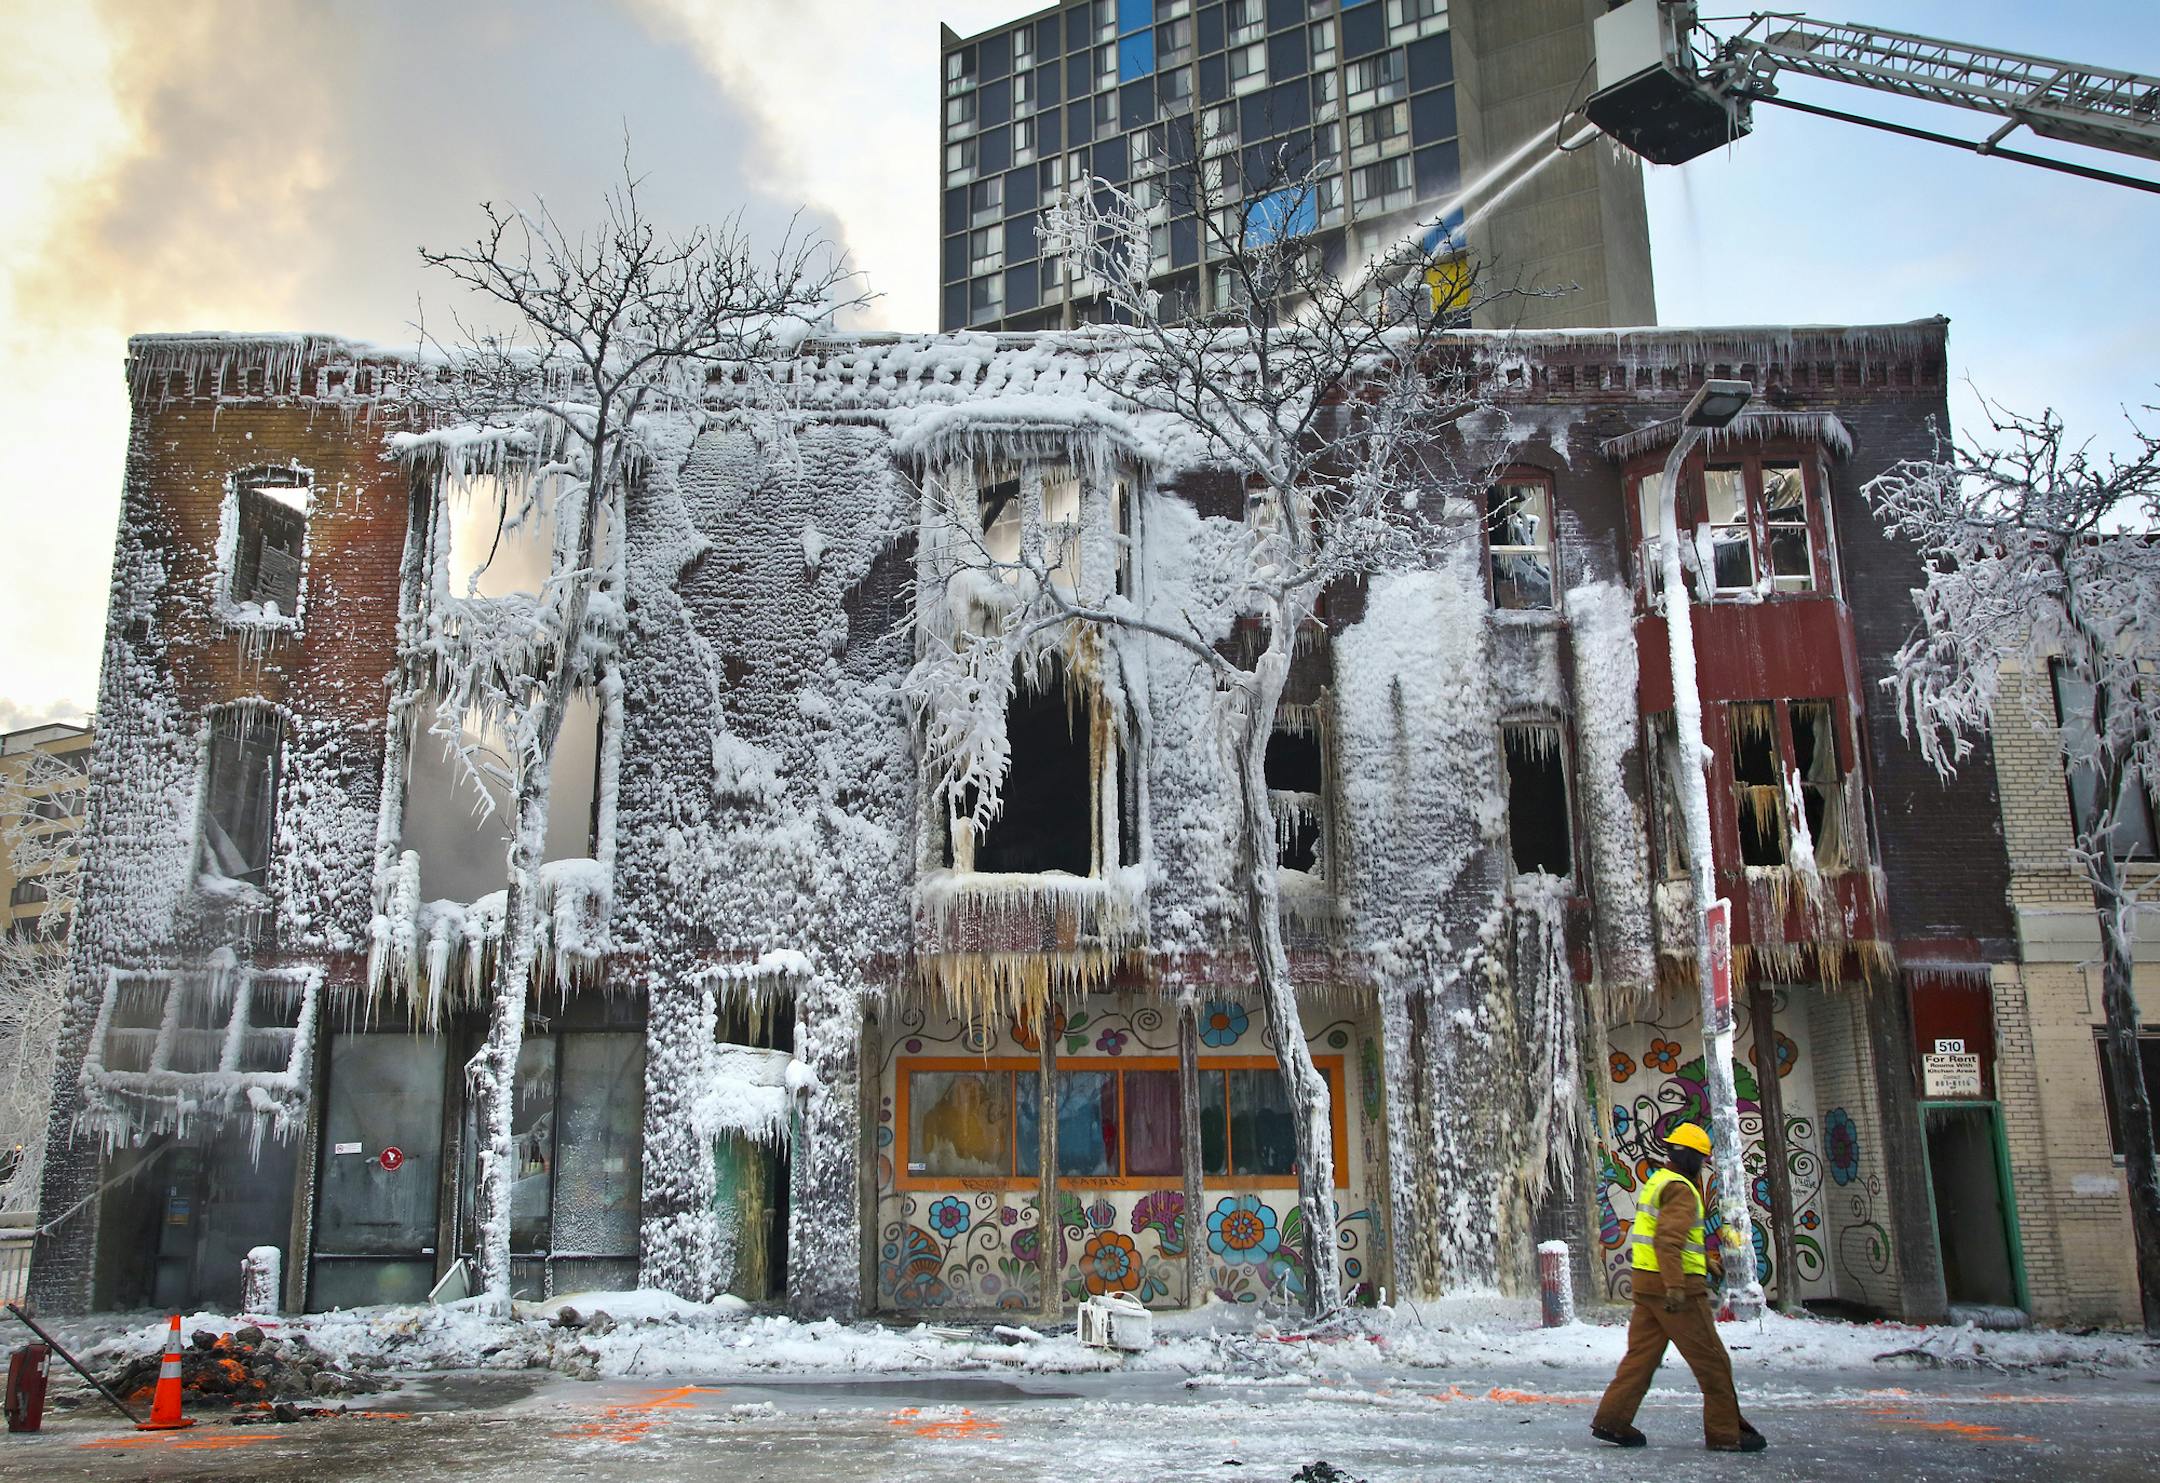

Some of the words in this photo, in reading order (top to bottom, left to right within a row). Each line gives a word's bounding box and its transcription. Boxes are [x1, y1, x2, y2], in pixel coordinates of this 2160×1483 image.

[1939, 1041, 1961, 1052] 510
[1926, 1055, 1945, 1063] For
[1949, 1055, 1976, 1063] Rent
